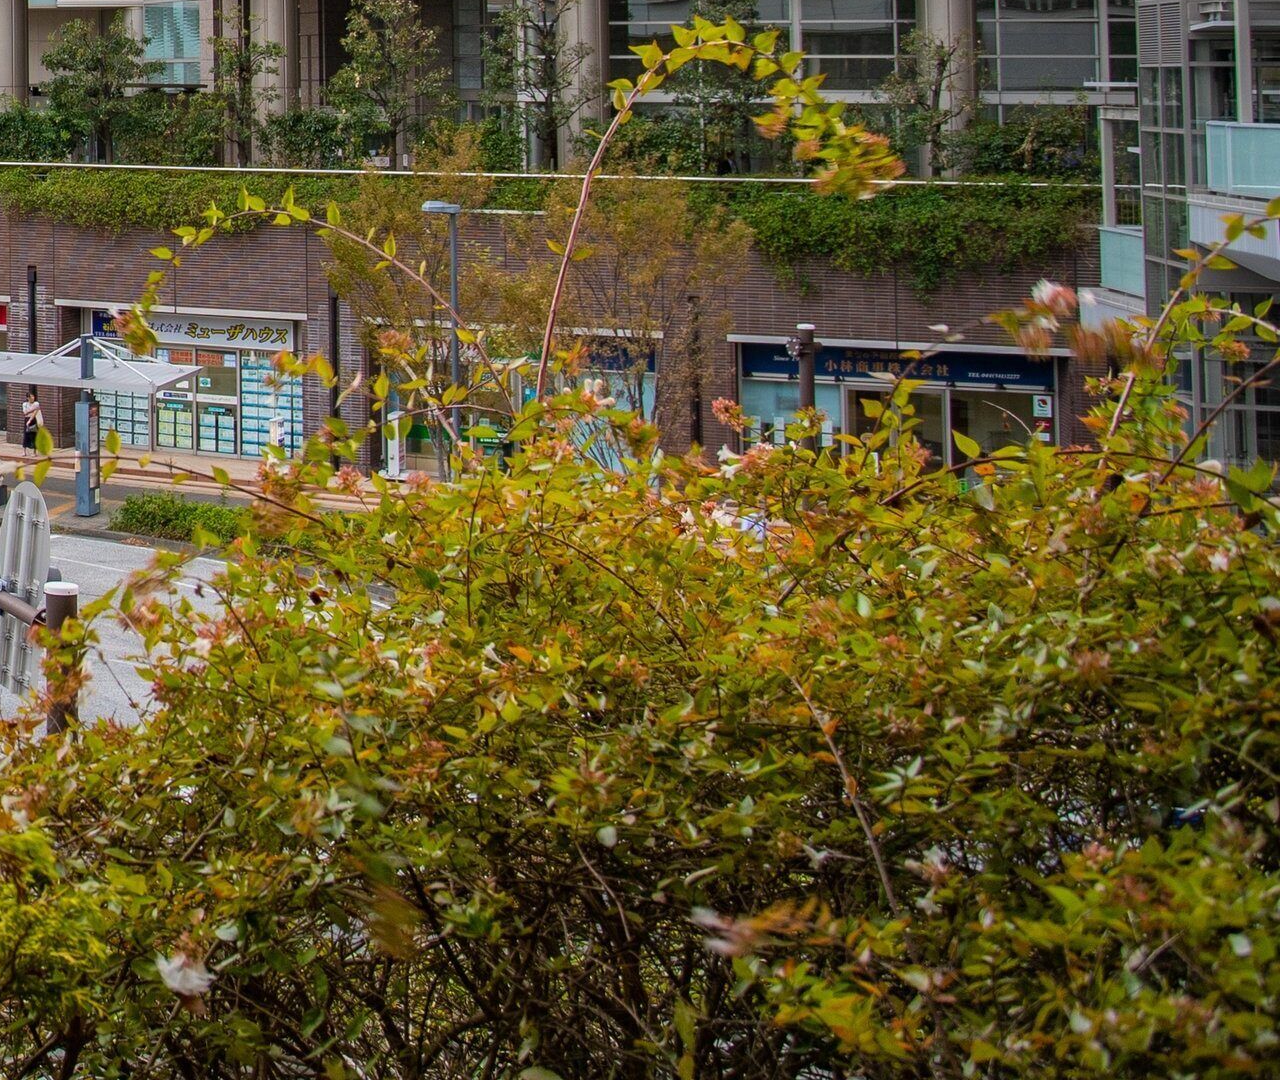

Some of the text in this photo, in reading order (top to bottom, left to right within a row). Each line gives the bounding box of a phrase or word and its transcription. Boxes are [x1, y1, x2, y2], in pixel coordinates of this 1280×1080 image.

[185, 323, 288, 344] ミューザハウス
